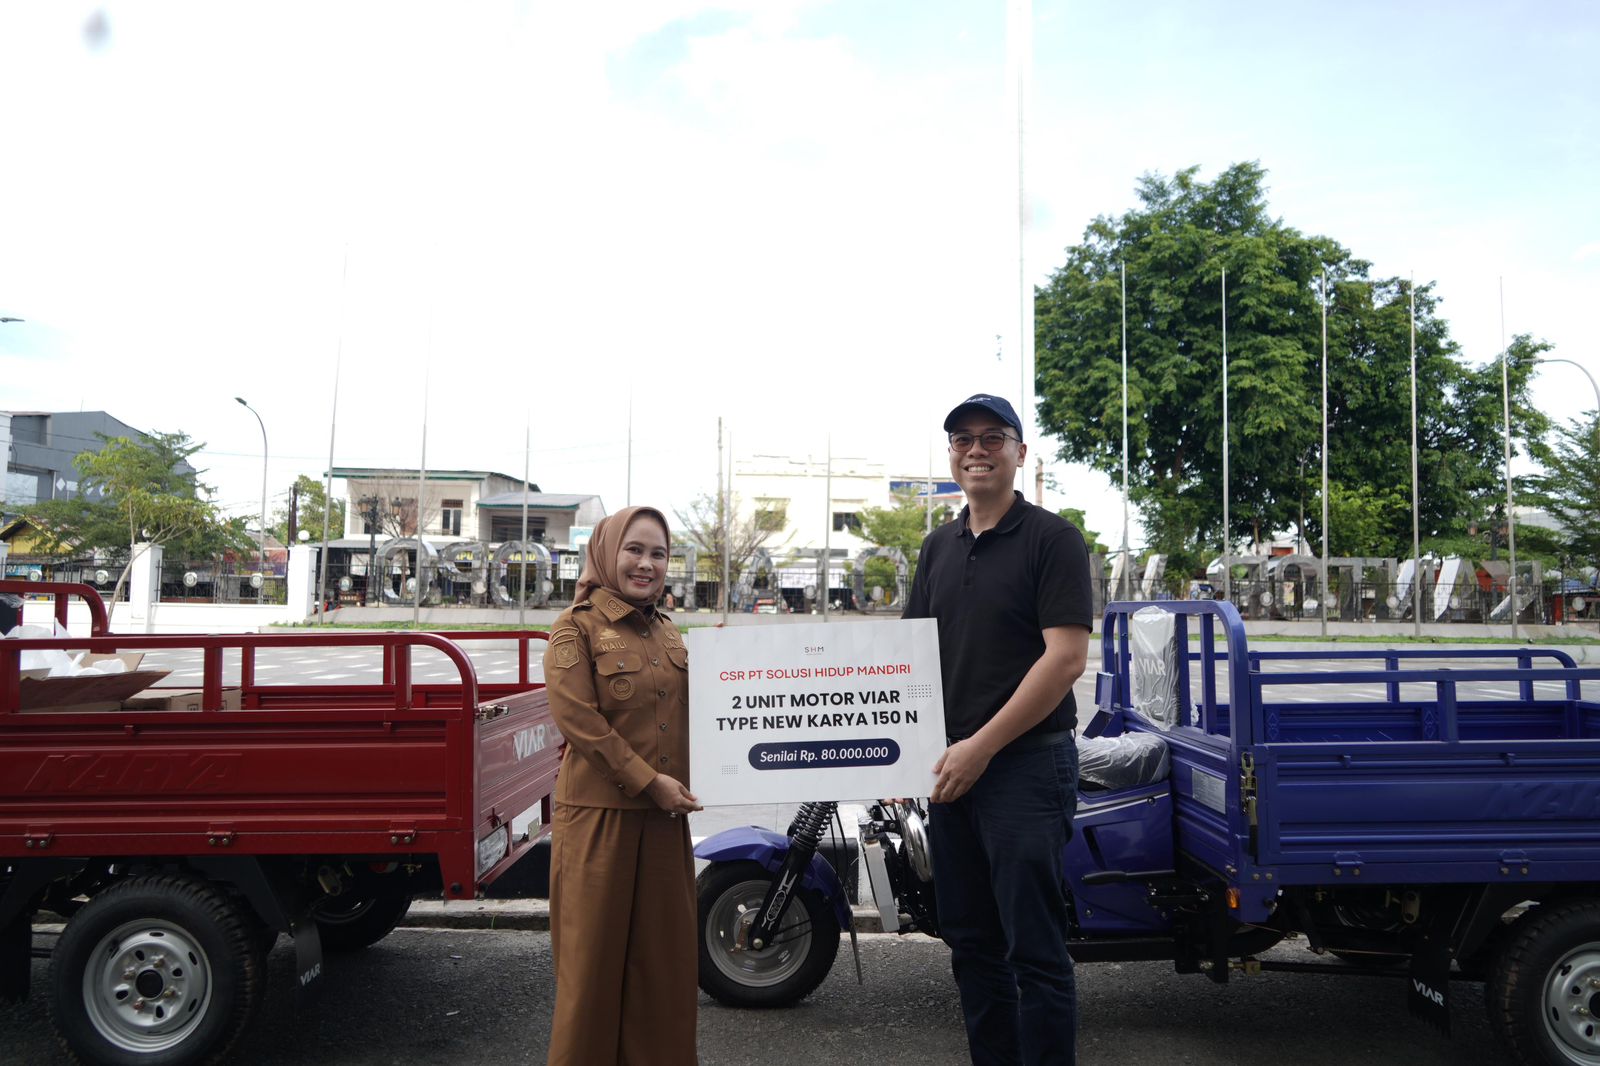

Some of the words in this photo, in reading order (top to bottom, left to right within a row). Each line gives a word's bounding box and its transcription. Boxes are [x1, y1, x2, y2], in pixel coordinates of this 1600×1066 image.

[600, 640, 628, 651] NAILI
[719, 670, 746, 681] CSR
[748, 670, 763, 680] PT
[766, 668, 811, 680] SOLUSI
[815, 666, 854, 677] HIDUP
[857, 664, 911, 676] MANDIRI
[1138, 657, 1166, 676] VIAR
[732, 695, 742, 710] 2
[745, 694, 786, 709] UNIT
[790, 691, 855, 707] MOTOR
[858, 690, 901, 705] VIAR
[716, 717, 758, 731] TYPE
[762, 714, 803, 730] NEW
[807, 712, 868, 728] KARYA
[871, 710, 901, 725] 150
[905, 710, 918, 724] N
[512, 723, 546, 762] VIAR
[760, 750, 798, 763] Senilai
[800, 750, 818, 763] Rp.
[821, 746, 889, 760] 80.000.000
[300, 963, 321, 986] VIAR
[1412, 977, 1445, 1007] VIAR
